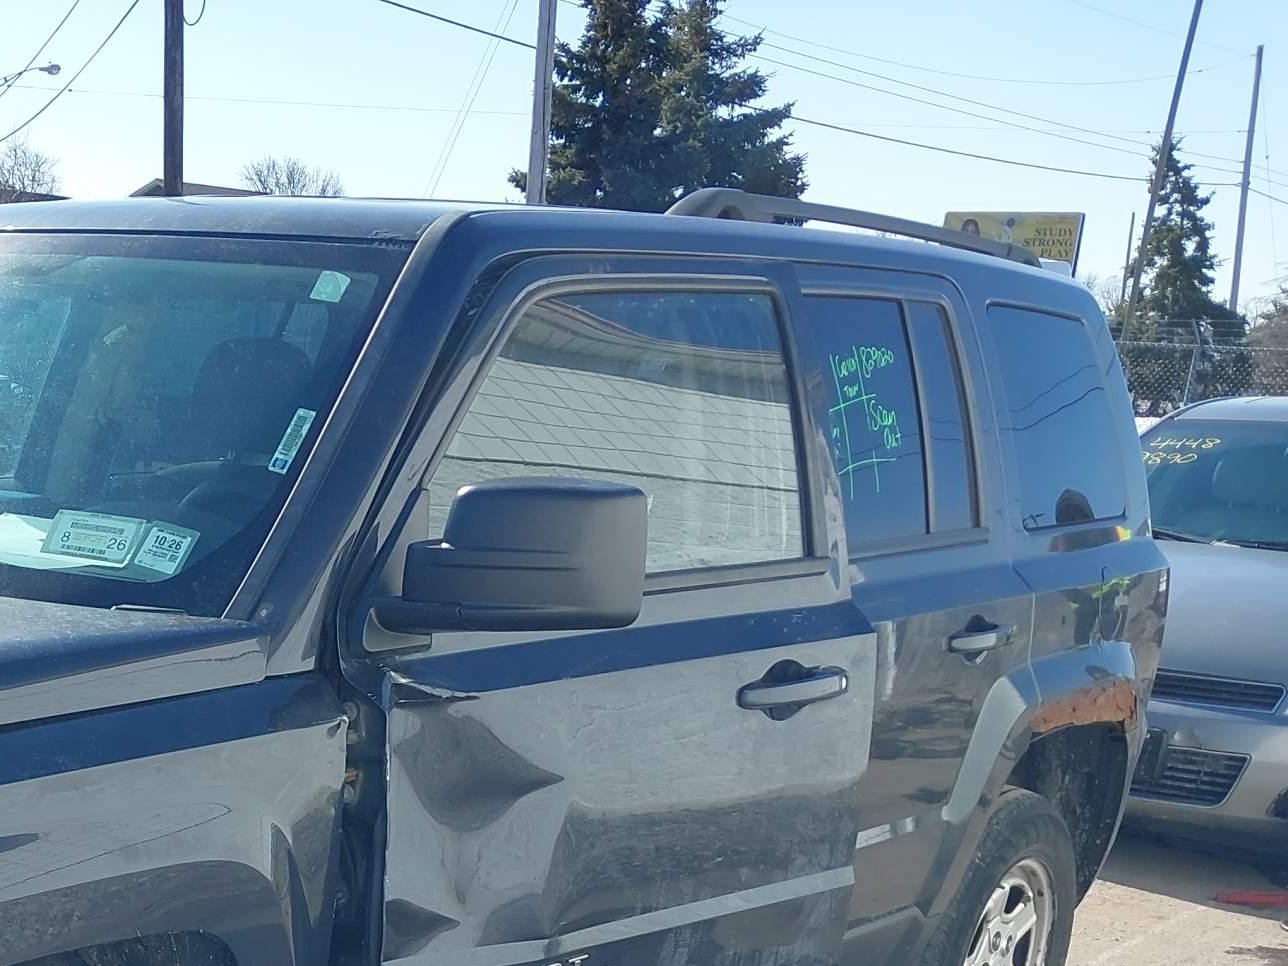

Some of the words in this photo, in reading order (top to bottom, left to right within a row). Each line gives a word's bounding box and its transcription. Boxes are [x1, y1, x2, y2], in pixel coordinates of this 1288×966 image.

[1034, 227, 1074, 238] STUDY
[1022, 237, 1073, 247] STRONG
[1040, 247, 1070, 258] PLAY
[1149, 436, 1221, 449] 4448
[60, 531, 72, 543] 8
[106, 537, 129, 551] 26
